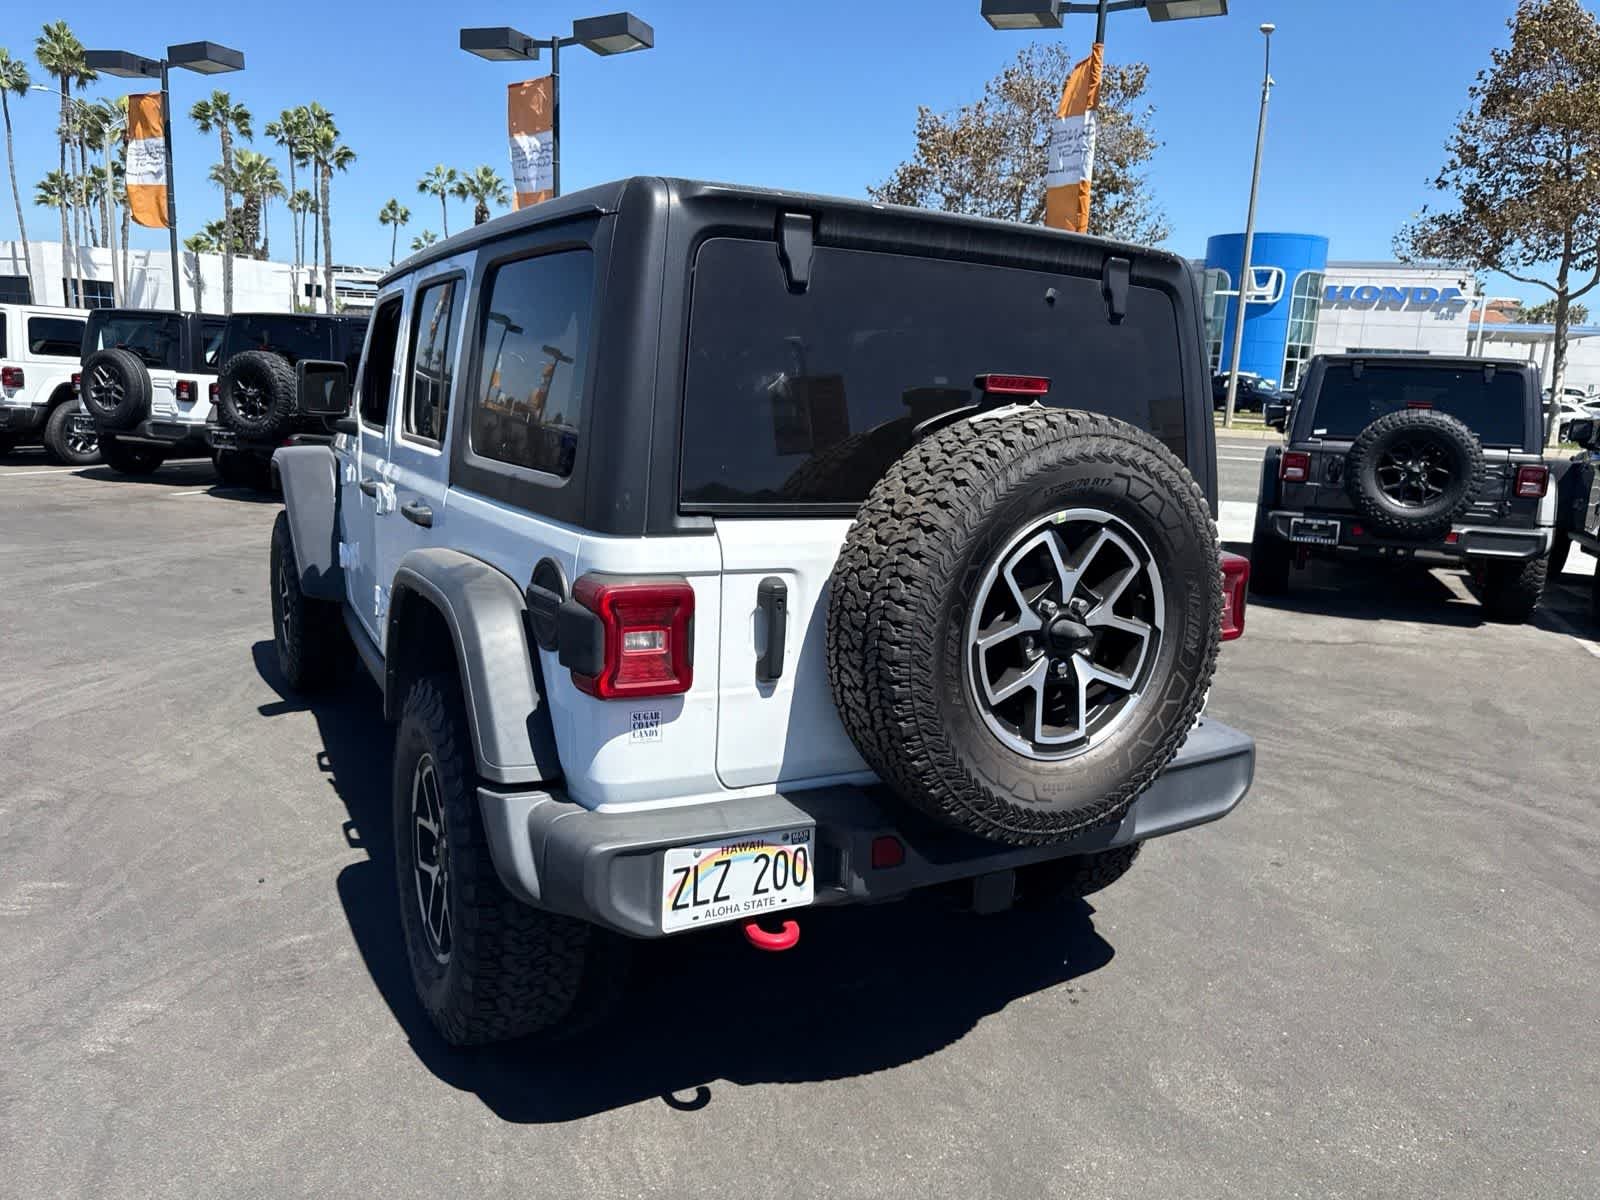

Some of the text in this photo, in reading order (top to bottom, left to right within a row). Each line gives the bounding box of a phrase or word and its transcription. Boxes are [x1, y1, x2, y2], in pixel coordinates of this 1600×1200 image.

[1322, 285, 1468, 309] HONDA
[632, 711, 660, 722] SUGAR
[632, 720, 659, 730] COAST
[632, 729, 658, 739] CANDY
[721, 840, 764, 856] HAWAII
[672, 846, 808, 912] ZLZ 200
[704, 896, 776, 920] ALOHA STATE
